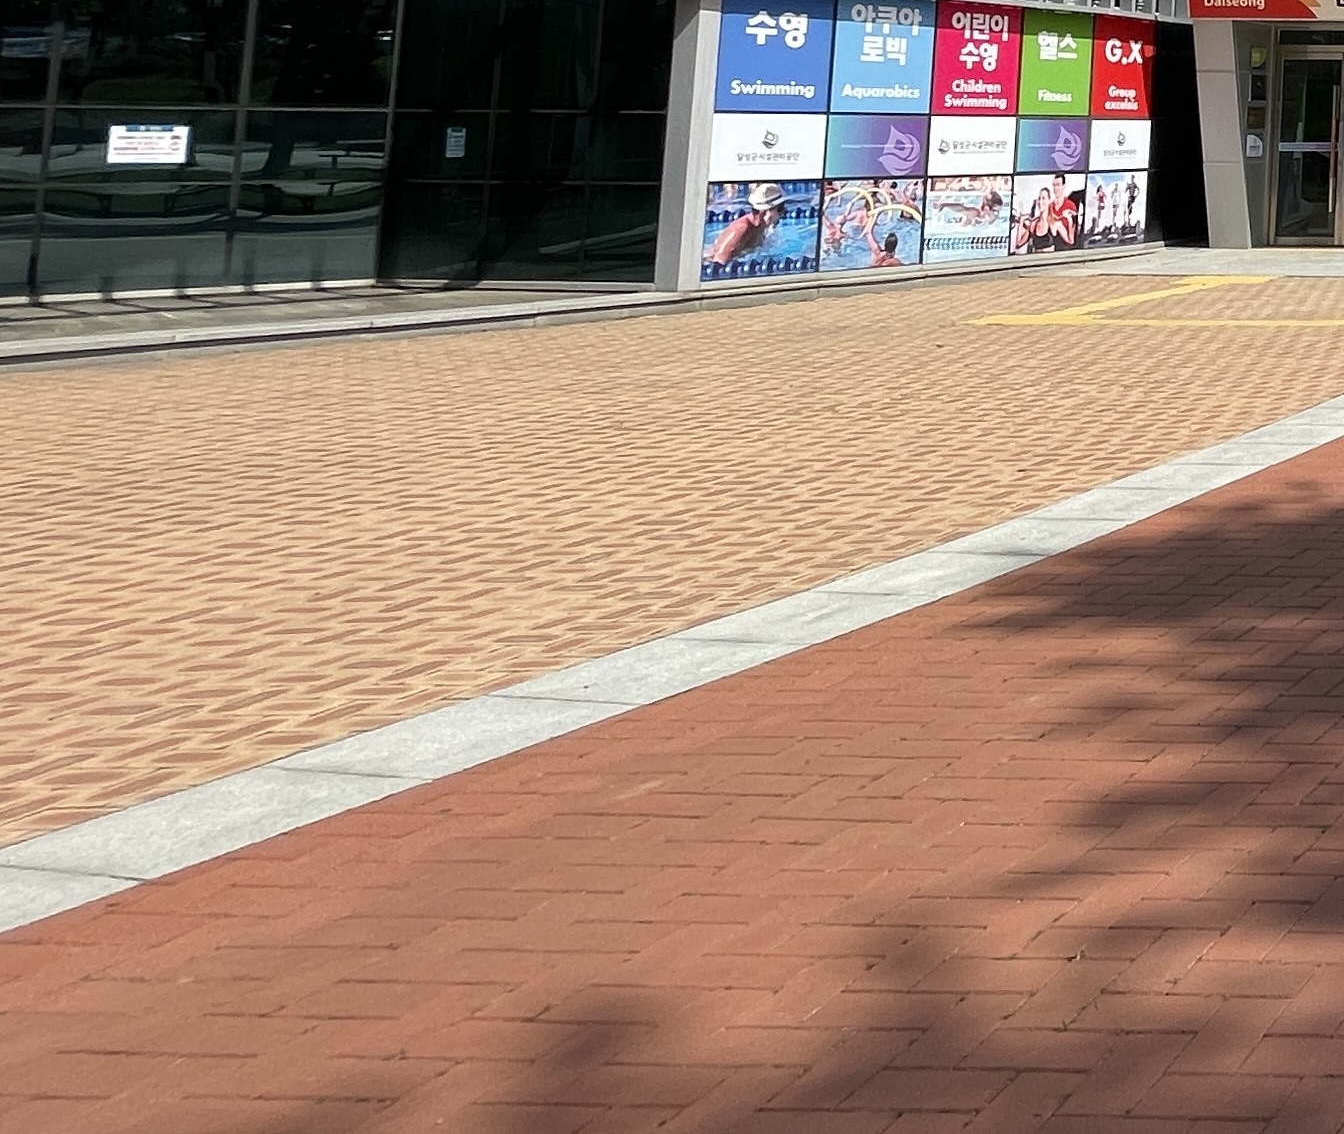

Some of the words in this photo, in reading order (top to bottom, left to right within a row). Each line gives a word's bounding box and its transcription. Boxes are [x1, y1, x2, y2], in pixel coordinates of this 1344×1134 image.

[745, 10, 809, 49] 수영
[851, 3, 923, 36] 아쿠아
[952, 11, 1009, 42] 어린이
[859, 35, 908, 66] 로빅
[959, 41, 999, 72] 수영
[1037, 30, 1078, 61] 헬스
[1105, 37, 1144, 66] G.X
[730, 79, 815, 99] Swimming
[841, 83, 920, 100] Aquarobics
[952, 78, 1002, 94] Children
[1037, 88, 1072, 103] Fitness
[1108, 85, 1137, 102] Group
[944, 94, 1007, 111] Swimming
